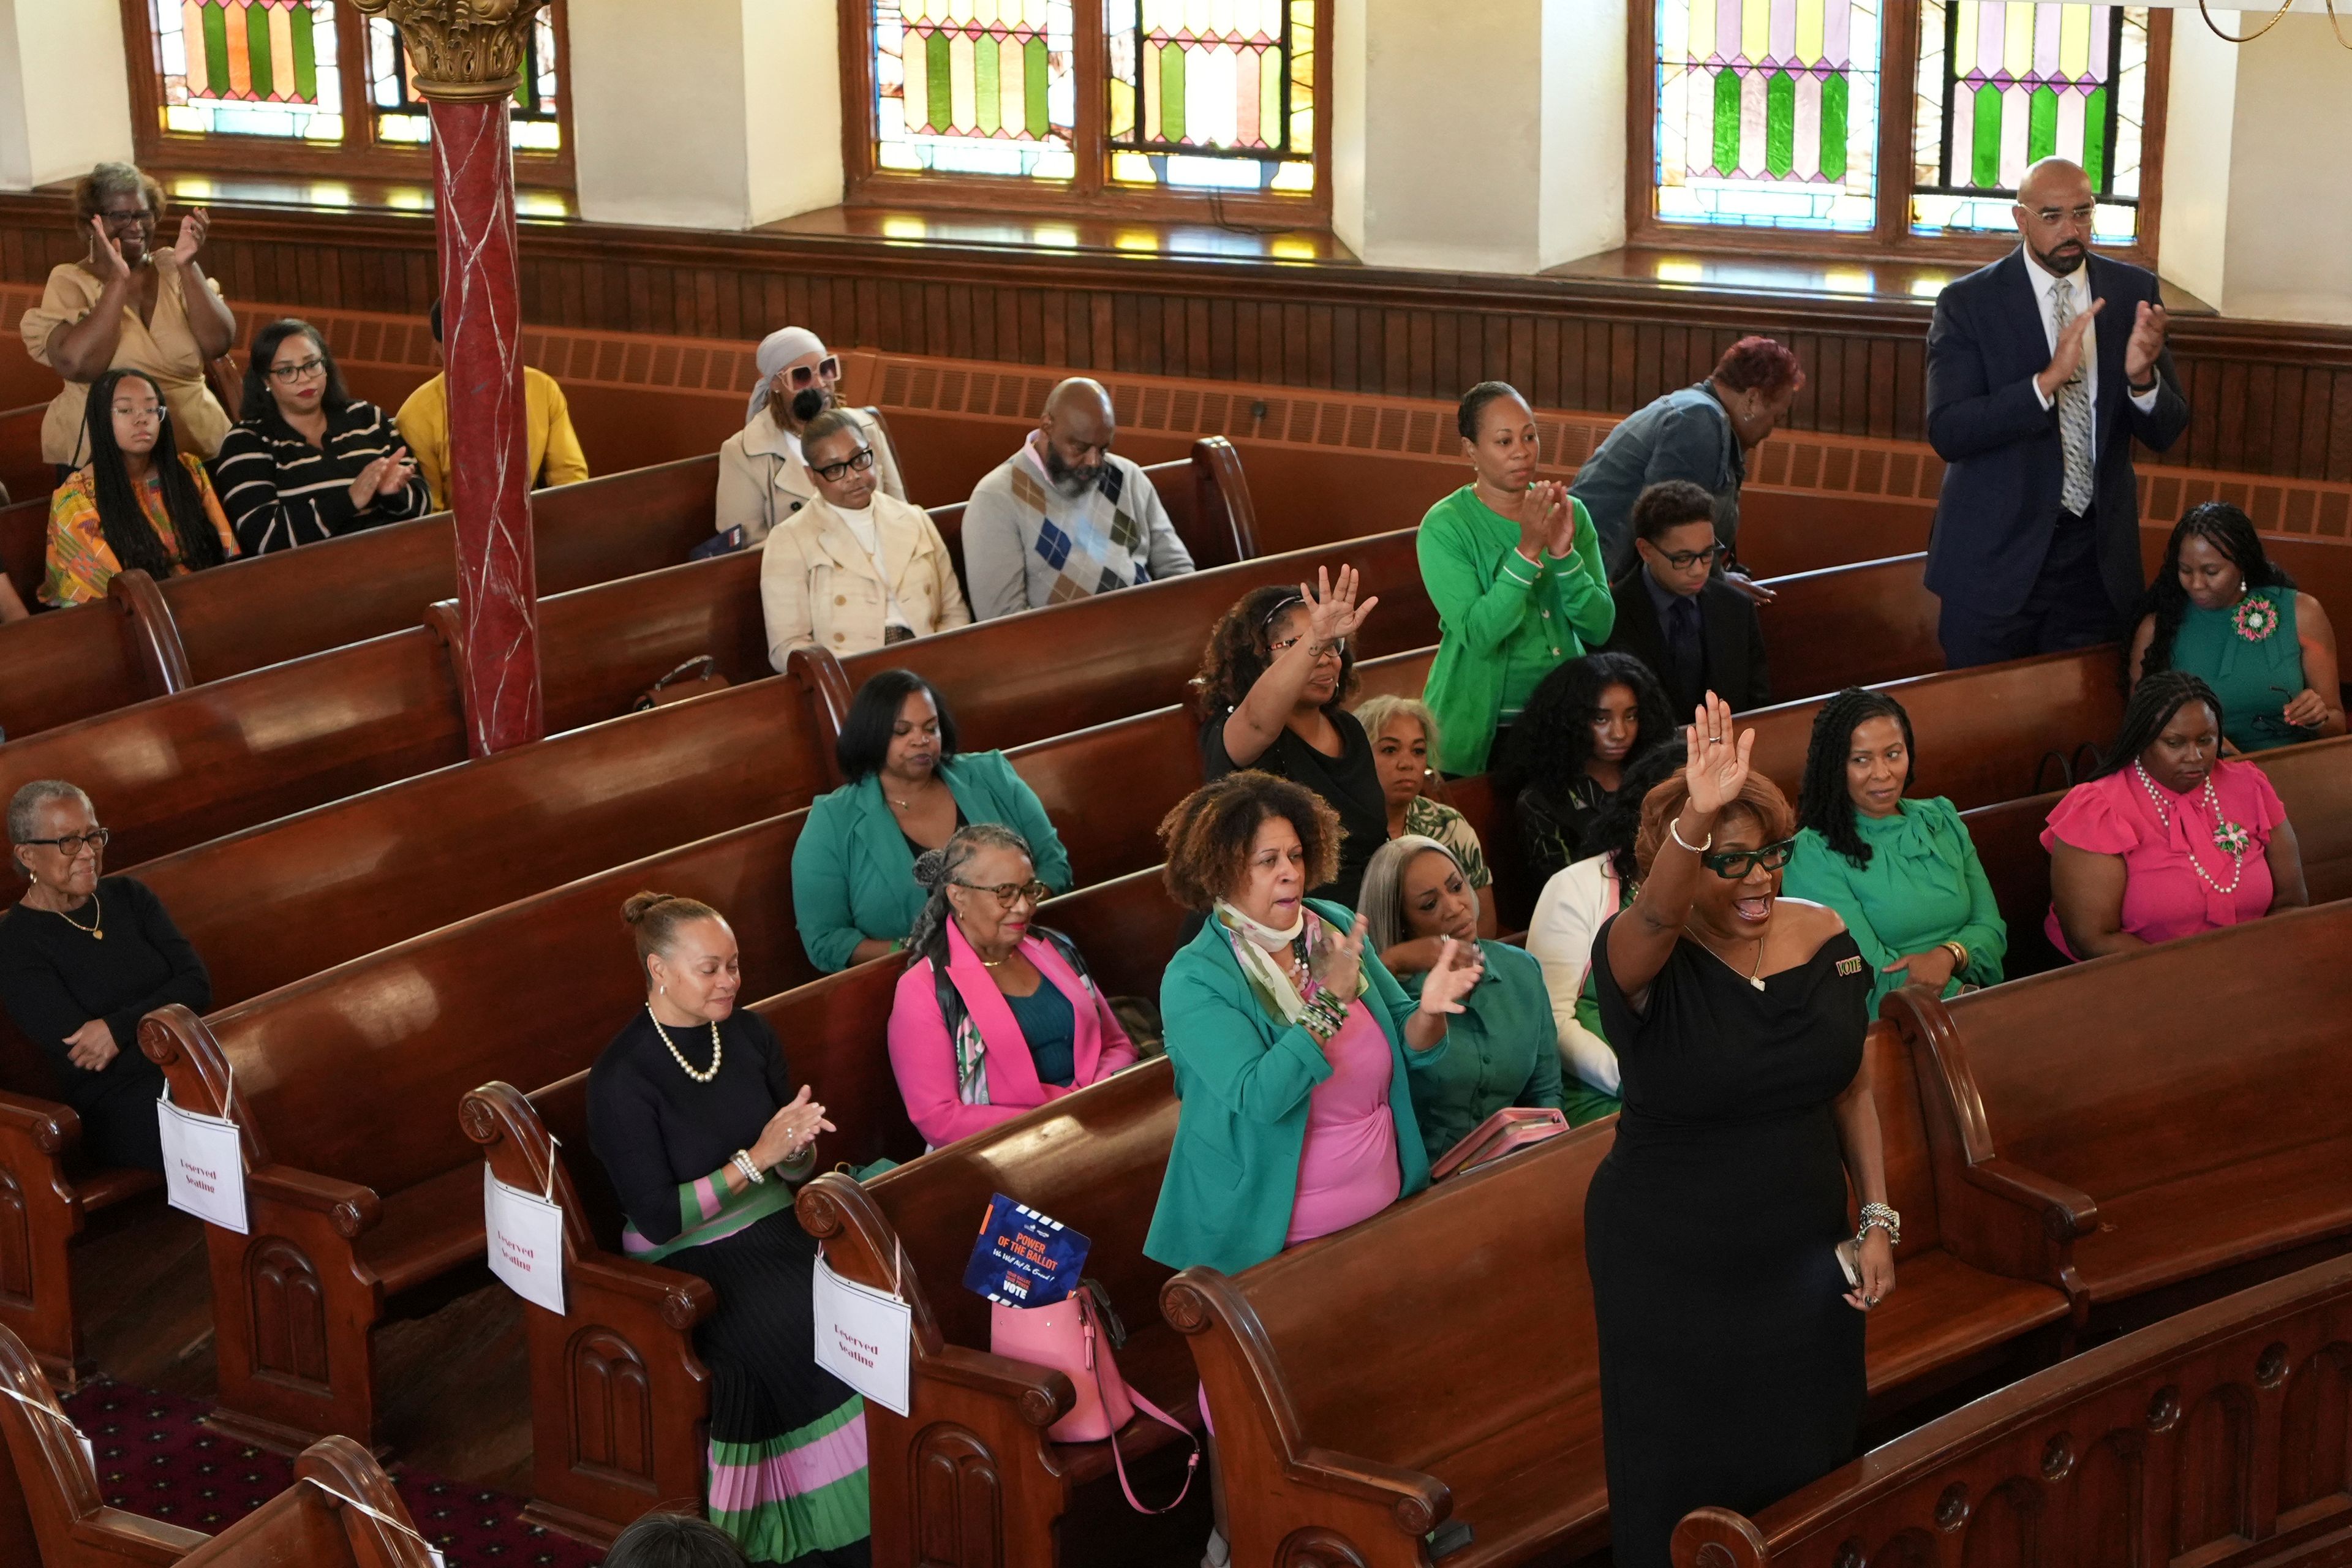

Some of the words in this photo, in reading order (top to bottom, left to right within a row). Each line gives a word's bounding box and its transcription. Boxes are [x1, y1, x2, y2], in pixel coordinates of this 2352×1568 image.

[1836, 956, 1861, 976] VOTE
[180, 1159, 216, 1180] Reserved
[186, 1175, 214, 1193] Seating
[998, 1235, 1010, 1248] OF
[1010, 1241, 1027, 1256] THE
[1026, 1250, 1058, 1270] BALLOT
[1016, 1232, 1046, 1254] POWER
[992, 1248, 1002, 1257] We
[1002, 1253, 1016, 1264] Will
[1003, 1280, 1027, 1299] VOTE
[834, 1324, 878, 1355] Reserved
[839, 1341, 874, 1368] Seating
